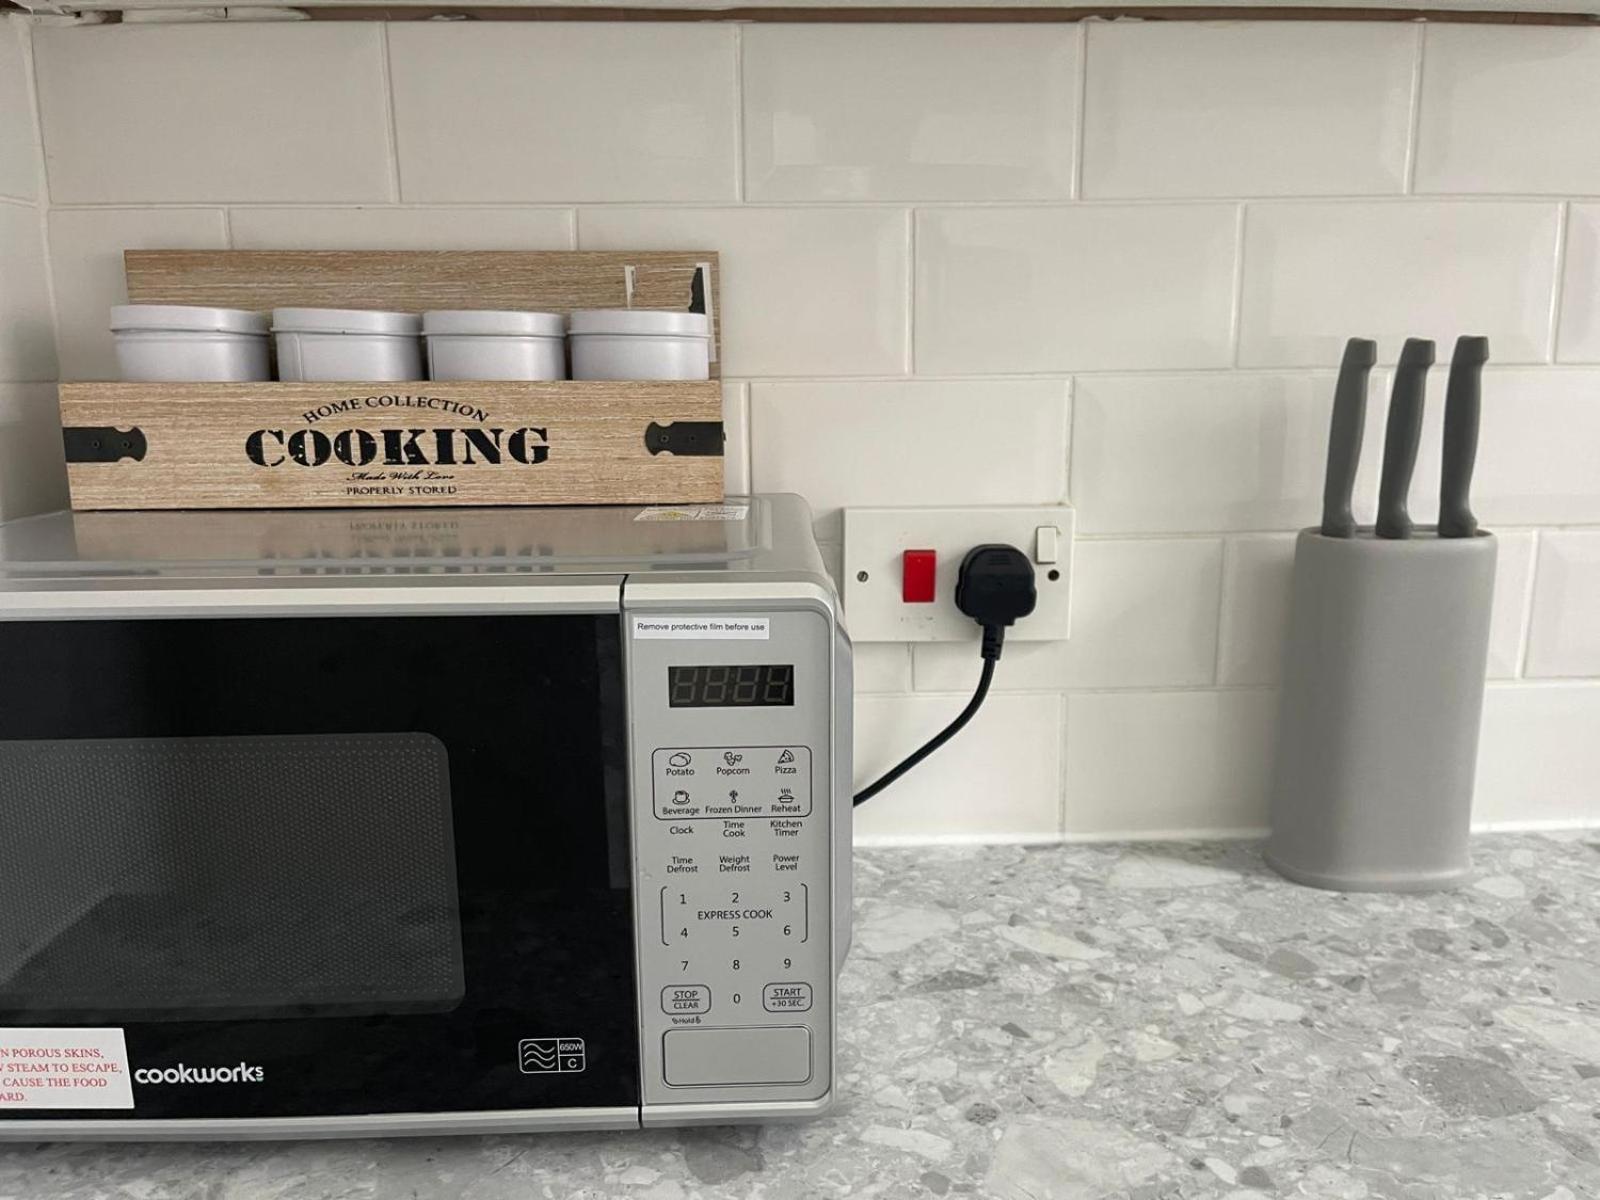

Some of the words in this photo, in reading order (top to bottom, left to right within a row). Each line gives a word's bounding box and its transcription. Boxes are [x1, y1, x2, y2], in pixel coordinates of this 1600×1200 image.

[302, 397, 362, 424] HOME
[364, 395, 489, 423] COLLECTION
[245, 427, 550, 467] COOKING
[346, 471, 387, 481] Made
[389, 469, 424, 481] With
[424, 470, 455, 481] Love
[346, 486, 404, 496] PROPERLY
[408, 485, 457, 495] STORED
[637, 622, 669, 631] Remove
[671, 622, 708, 632] protective
[709, 622, 723, 631] film
[725, 622, 749, 631] before
[666, 768, 694, 776] Potato
[716, 766, 750, 775] Popcorn
[775, 766, 797, 774] Pizza
[662, 807, 700, 816] Beverage
[705, 806, 733, 814] Frozen
[734, 805, 762, 814] Dinner
[771, 804, 801, 813] Reheat
[724, 821, 745, 829] Time
[770, 820, 803, 829] Kitchen
[669, 826, 694, 835] Clock
[723, 829, 746, 837] Cook
[775, 828, 798, 837] Timer
[672, 856, 693, 864] Time
[719, 855, 750, 865] Weight
[773, 854, 799, 862] Power
[666, 865, 698, 873] Defrost
[719, 864, 750, 872] Defrost
[775, 863, 798, 871] Level
[680, 894, 687, 905] 1
[731, 892, 739, 903] 2
[783, 891, 791, 902] 3
[697, 910, 741, 920] EXPRESS
[743, 909, 773, 919] COOK
[680, 928, 688, 938] 4
[732, 926, 740, 937] 5
[783, 925, 791, 936] 6
[681, 960, 689, 972] 7
[732, 959, 740, 970] 8
[783, 958, 792, 969] 9
[674, 990, 698, 999] STOP
[773, 988, 802, 997] START
[733, 993, 741, 1004] 0
[673, 1001, 699, 1010] CLEAR
[560, 1043, 582, 1051] 650W
[12, 1048, 61, 1058] POROUS
[64, 1048, 104, 1059] SKINS,
[567, 1058, 577, 1068] C
[7, 1063, 49, 1072] STEAM
[51, 1063, 69, 1073] TO
[72, 1063, 122, 1073] ESCAPE,
[134, 1062, 264, 1084] cookworks
[3, 1078, 44, 1087] CAUSE
[47, 1078, 71, 1087] THE
[74, 1078, 107, 1087] FOOD
